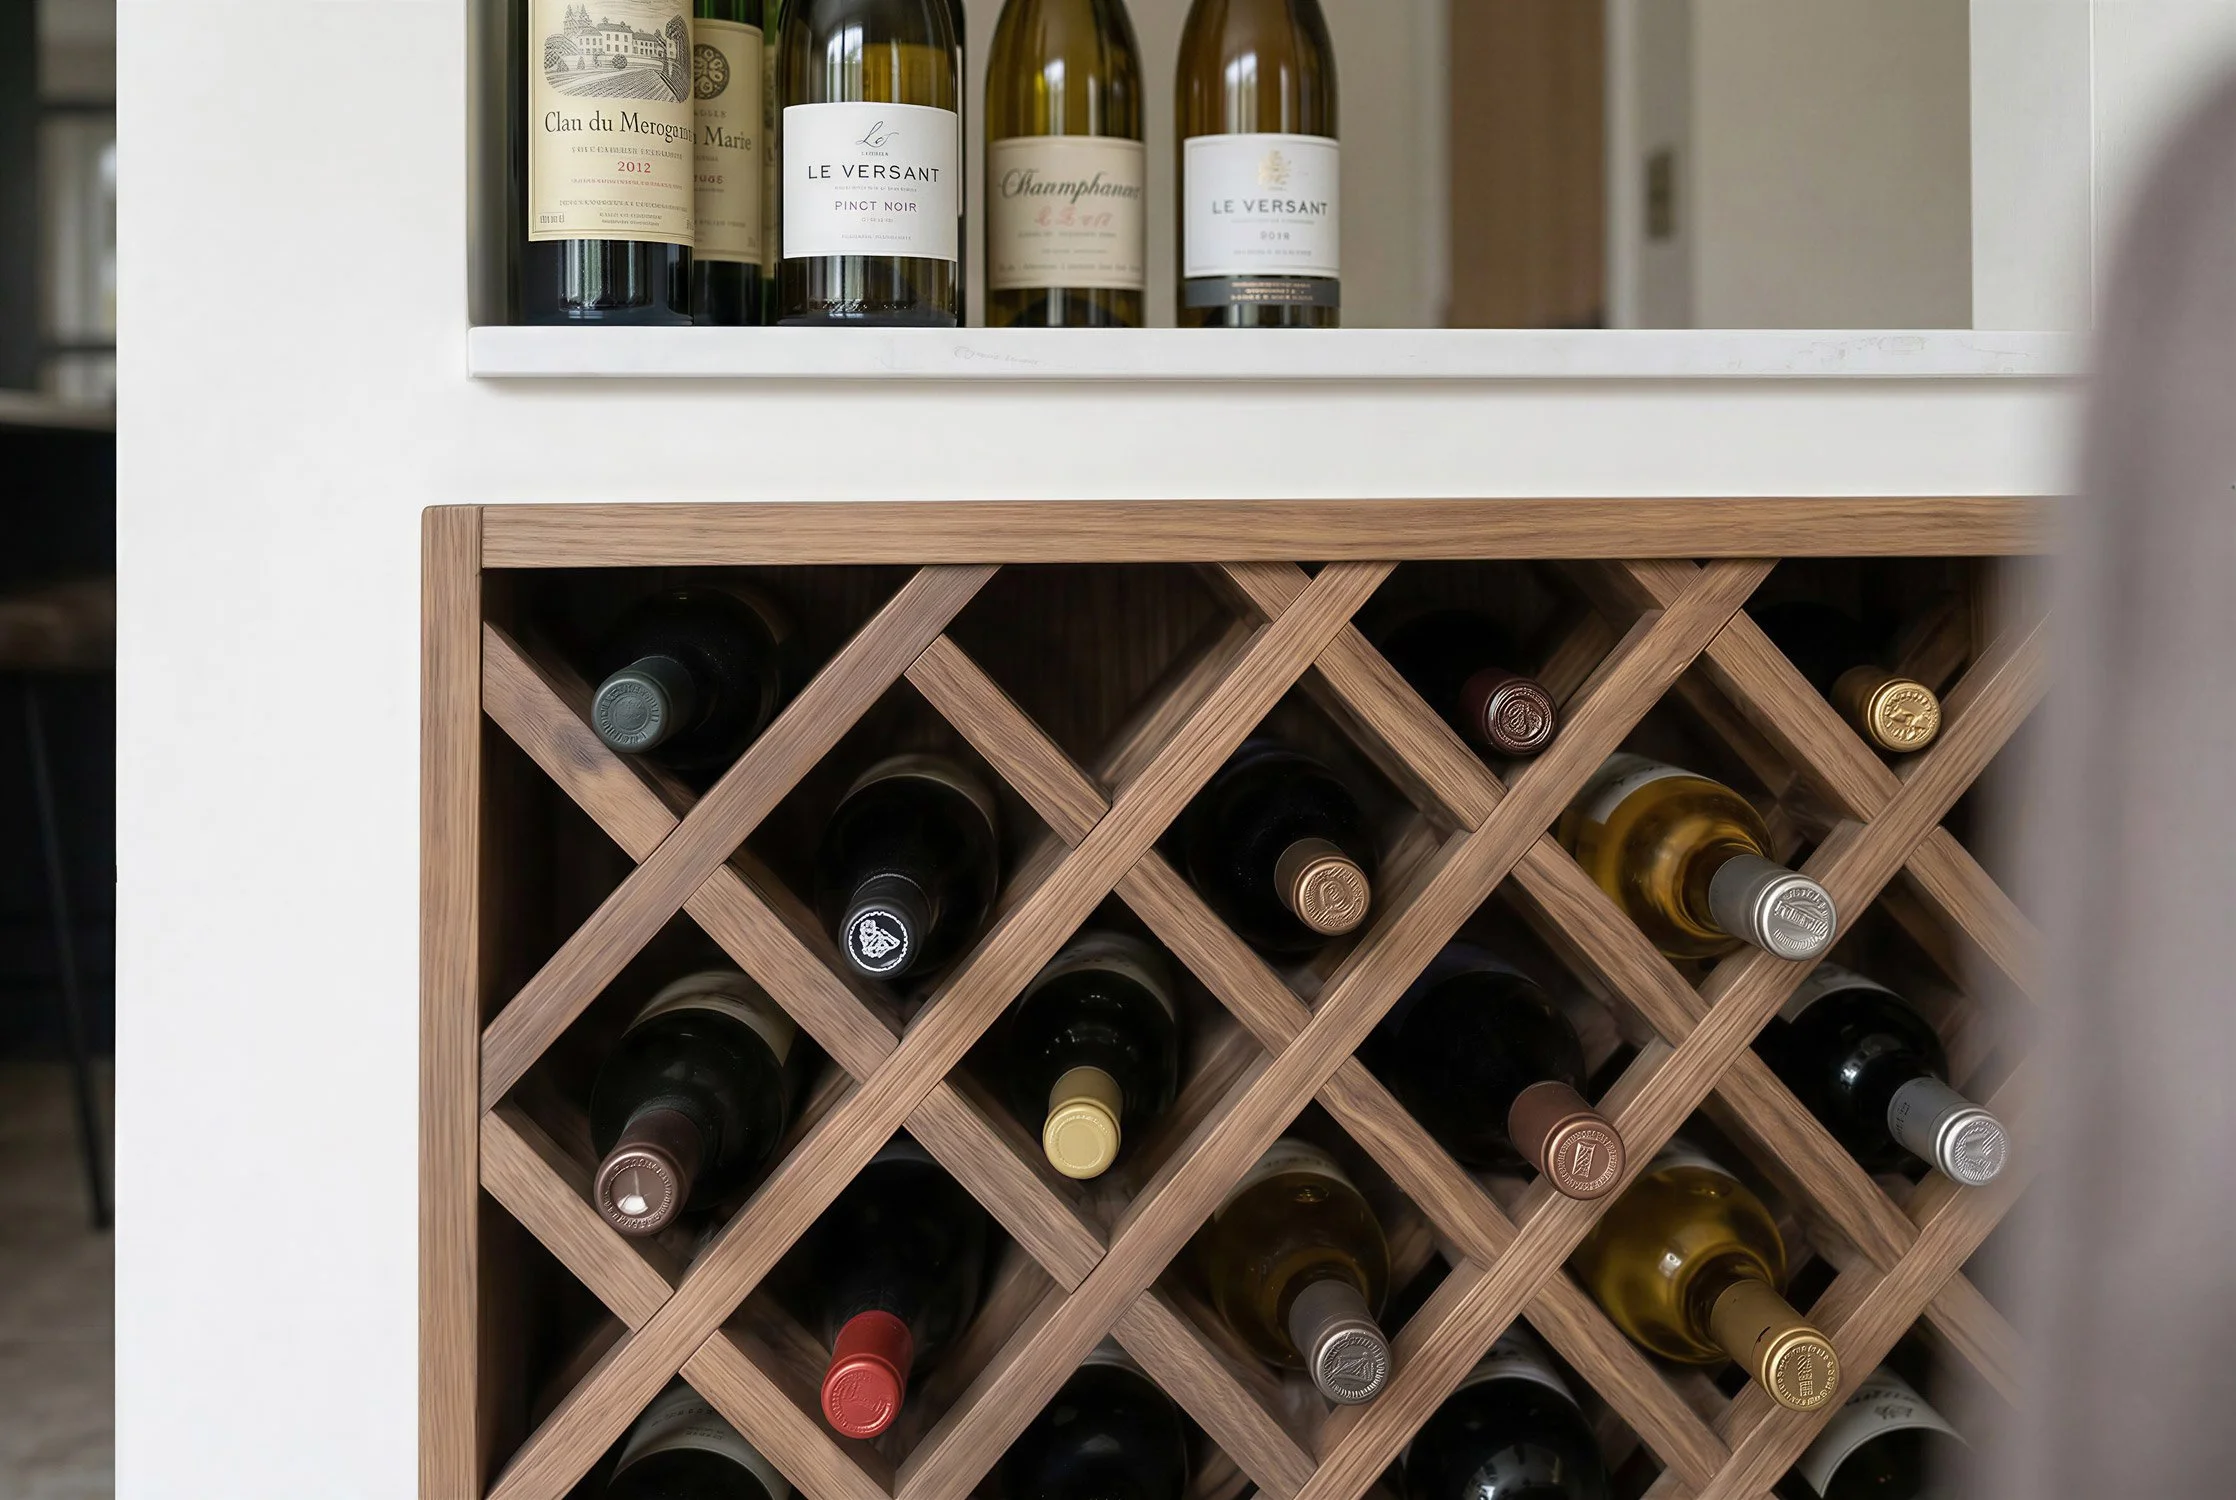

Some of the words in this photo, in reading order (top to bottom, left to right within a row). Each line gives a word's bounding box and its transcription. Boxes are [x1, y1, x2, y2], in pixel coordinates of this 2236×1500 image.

[589, 111, 612, 132] du
[617, 161, 651, 173] 2012
[808, 164, 831, 180] LE
[842, 164, 940, 183] VERSANT
[885, 201, 917, 212] NOIR
[1212, 200, 1234, 214] LE
[1243, 199, 1328, 216] VERSANT
